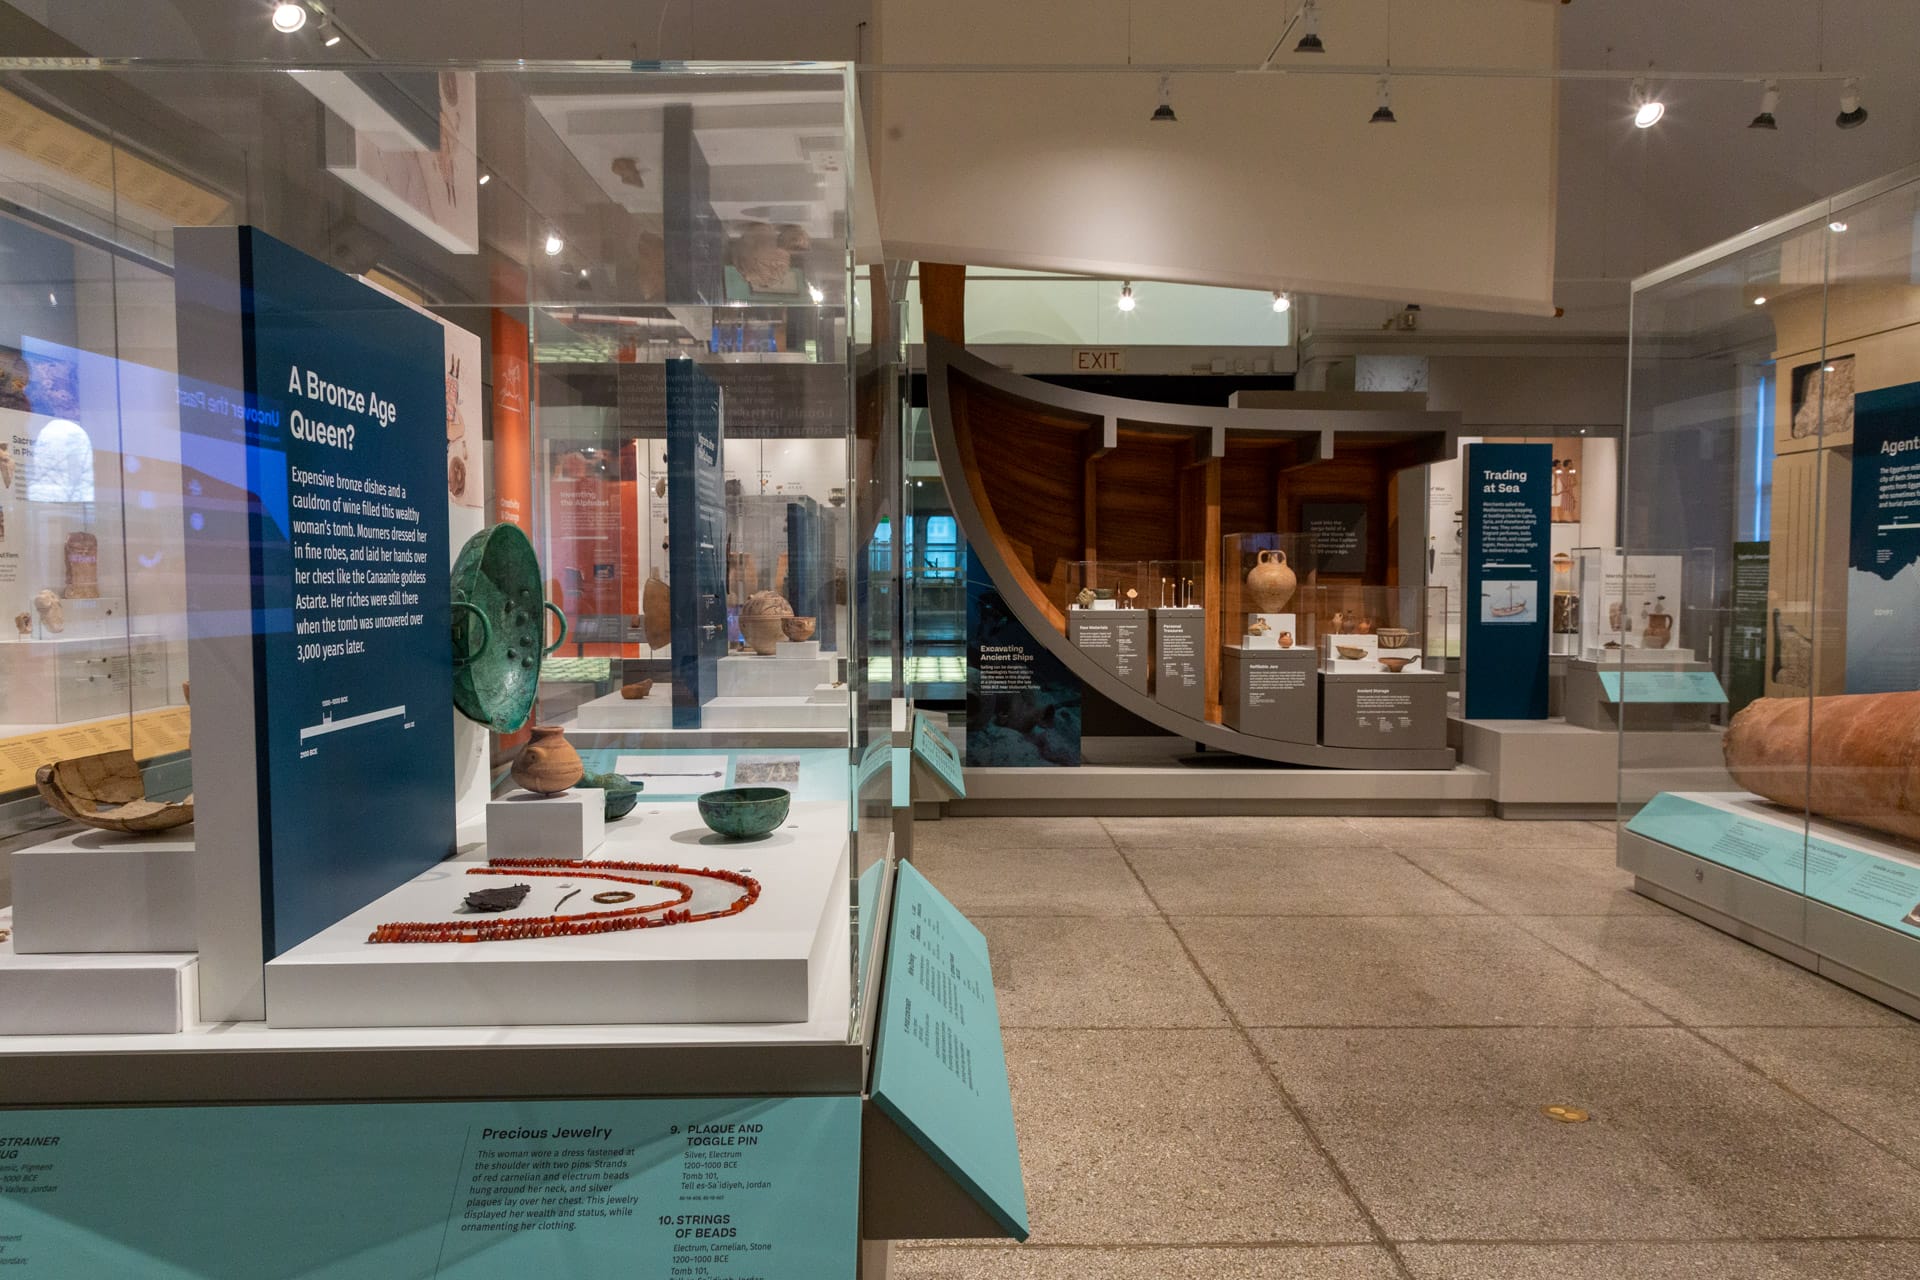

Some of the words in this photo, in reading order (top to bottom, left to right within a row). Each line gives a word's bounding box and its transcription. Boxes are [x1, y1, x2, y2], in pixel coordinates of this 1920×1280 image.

[1079, 352, 1120, 369] EXIT
[289, 365, 302, 396] A
[307, 370, 365, 413] Bronze
[369, 392, 396, 427] Age
[290, 410, 355, 450] Queen?
[1881, 438, 1920, 456] Agent
[292, 466, 334, 488] Expensive
[336, 473, 362, 492] bronze
[364, 478, 386, 495] dishes
[388, 484, 400, 498] and
[402, 488, 406, 498] a
[1484, 470, 1527, 482] Trading
[1483, 484, 1495, 493] at
[1498, 484, 1520, 493] Sea
[293, 493, 330, 511] cauldron
[333, 497, 341, 512] of
[343, 500, 360, 514] wine
[362, 502, 380, 517] filled
[382, 505, 394, 519] this
[396, 508, 419, 524] wealthy
[293, 520, 331, 533] woman's
[333, 522, 355, 537] tomb.
[357, 524, 390, 539] Mourners
[392, 529, 415, 541] dressed
[417, 530, 427, 542] her
[295, 542, 303, 559] in
[305, 542, 321, 560] fine
[324, 544, 348, 562] robes,
[351, 548, 364, 561] and
[366, 548, 379, 561] laid
[381, 549, 392, 561] her
[394, 550, 412, 562] hands
[414, 552, 427, 563] over
[296, 568, 310, 584] her
[313, 569, 335, 584] chest
[337, 569, 350, 584] like
[352, 570, 364, 583] the
[366, 569, 400, 583] Canaanite
[401, 571, 426, 587] goddess
[296, 594, 328, 609] Astarte.
[331, 593, 344, 608] Her
[347, 592, 369, 608] riches
[371, 597, 387, 606] were
[388, 592, 400, 605] still
[402, 591, 418, 605] there
[297, 617, 320, 634] when
[322, 617, 336, 632] the
[338, 616, 358, 631] tomb
[360, 617, 373, 629] was
[375, 613, 408, 628] uncovered
[410, 614, 423, 626] over
[297, 644, 321, 663] 3,000
[322, 644, 344, 661] years
[346, 639, 364, 654] later.
[980, 644, 1023, 653] Excavating
[482, 1126, 548, 1140] Precious
[552, 1126, 612, 1140] Jewelry
[670, 1125, 681, 1134] 9.
[688, 1124, 735, 1134] PLAQUE
[738, 1124, 763, 1133] AND
[0, 1137, 60, 1146] STRAINER
[687, 1137, 734, 1146] TOGGLE
[738, 1136, 758, 1145] PIN
[0, 1150, 18, 1159] UG
[685, 1151, 707, 1159] Silver,
[472, 1174, 482, 1183] of
[469, 1185, 492, 1195] hung
[528, 1185, 543, 1193] her
[545, 1185, 567, 1193] neck,
[746, 1181, 771, 1189] Jordan
[466, 1198, 502, 1209] plaques
[504, 1198, 517, 1207] lay
[541, 1197, 557, 1205] her
[587, 1196, 605, 1204] This
[606, 1196, 638, 1205] jewelry
[464, 1209, 507, 1220] displayed
[509, 1210, 524, 1218] her
[526, 1208, 556, 1217] wealth
[577, 1209, 607, 1217] status,
[609, 1208, 632, 1216] while
[658, 1216, 674, 1225] 10.
[677, 1214, 730, 1225] STRINGS
[461, 1221, 519, 1232] ornamenting
[538, 1221, 576, 1231] clothing.
[675, 1229, 692, 1238] OF
[695, 1228, 737, 1238] BEADS
[674, 1244, 708, 1253] Electrum,
[710, 1242, 749, 1251] Carnelian,
[750, 1242, 771, 1250] Stone
